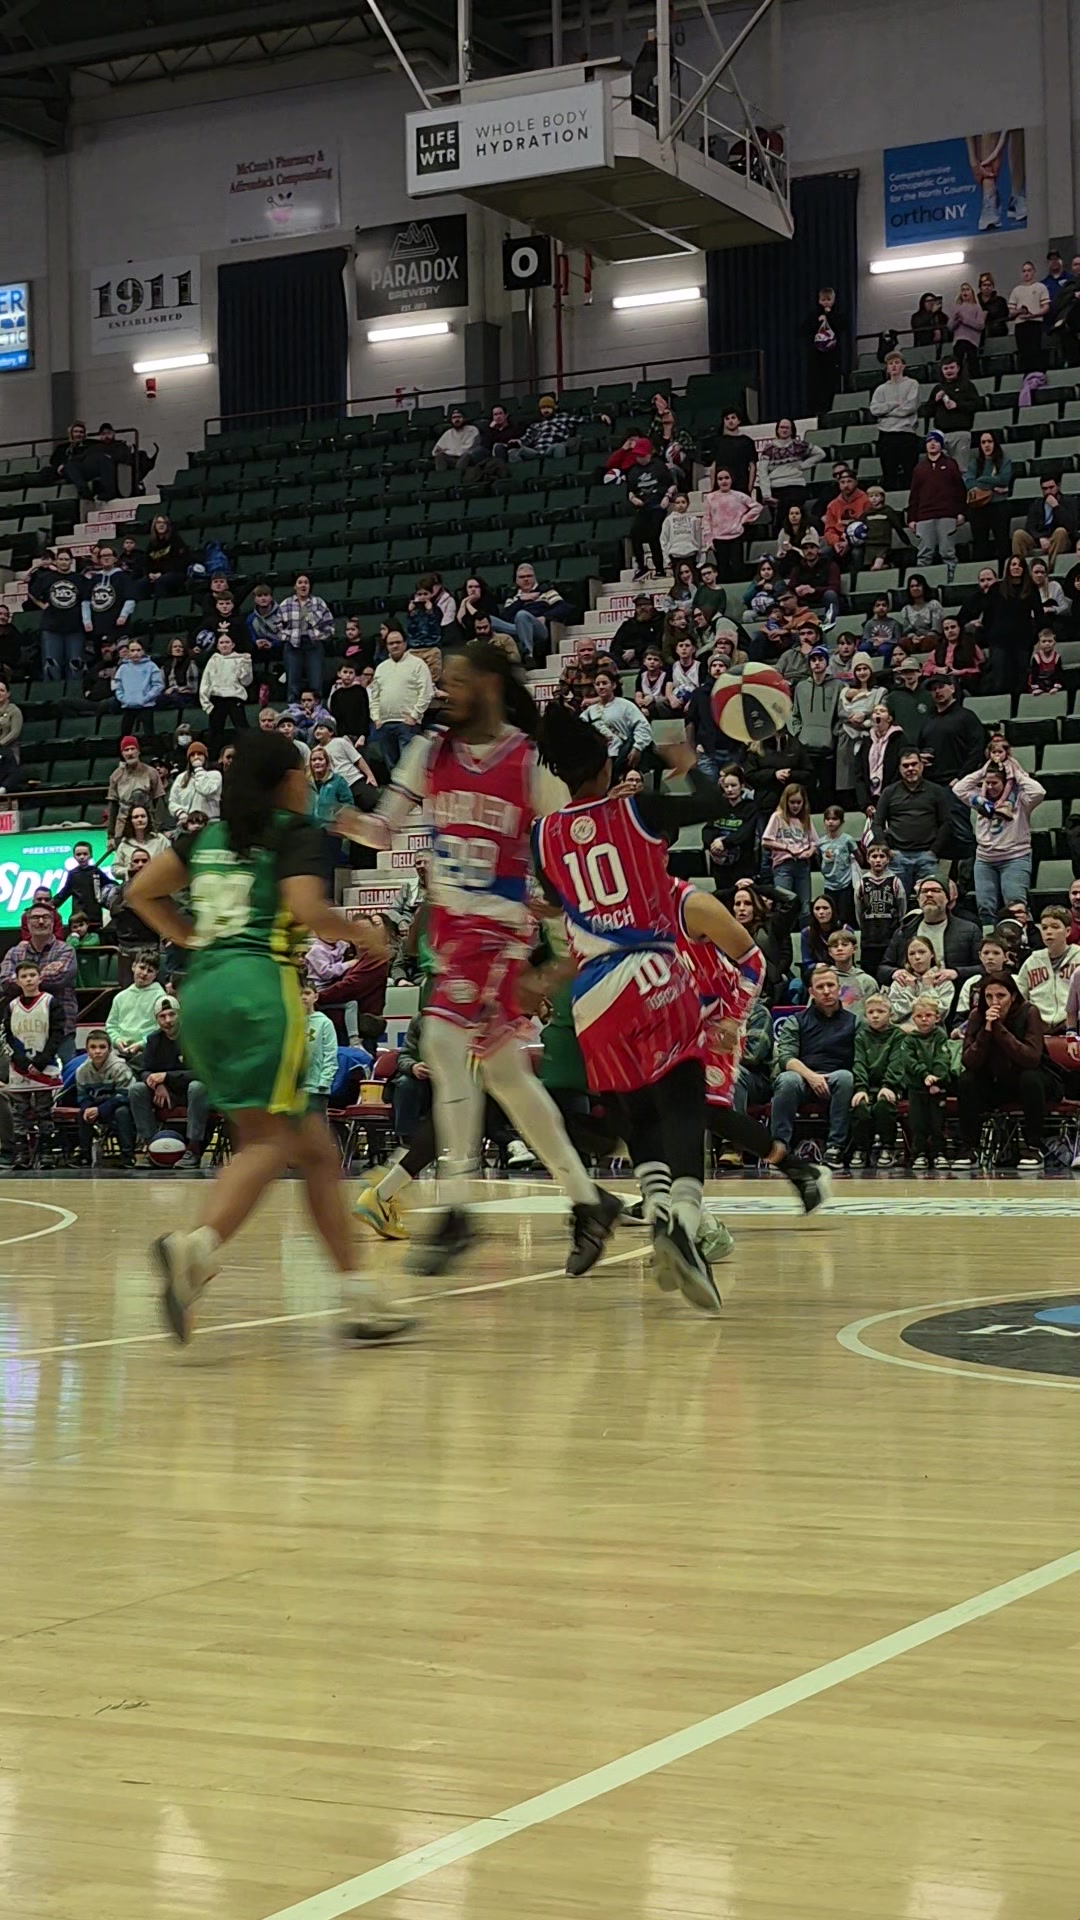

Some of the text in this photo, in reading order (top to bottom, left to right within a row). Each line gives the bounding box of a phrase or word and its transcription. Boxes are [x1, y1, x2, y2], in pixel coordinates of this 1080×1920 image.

[476, 109, 588, 138] WHOLE BODY
[420, 130, 456, 149] LIFE
[476, 127, 588, 157] HYDRATION
[420, 148, 456, 167] WTR
[889, 175, 956, 193] Orthopedic Care
[889, 183, 977, 203] for the North Country
[890, 203, 968, 228] orthoNY
[371, 256, 459, 291] PARADOX
[92, 270, 199, 319] 1911
[388, 285, 440, 301] BREWERY
[109, 313, 183, 329] ESTABLISHED
[563, 842, 629, 913] 10
[634, 951, 671, 996] 10
